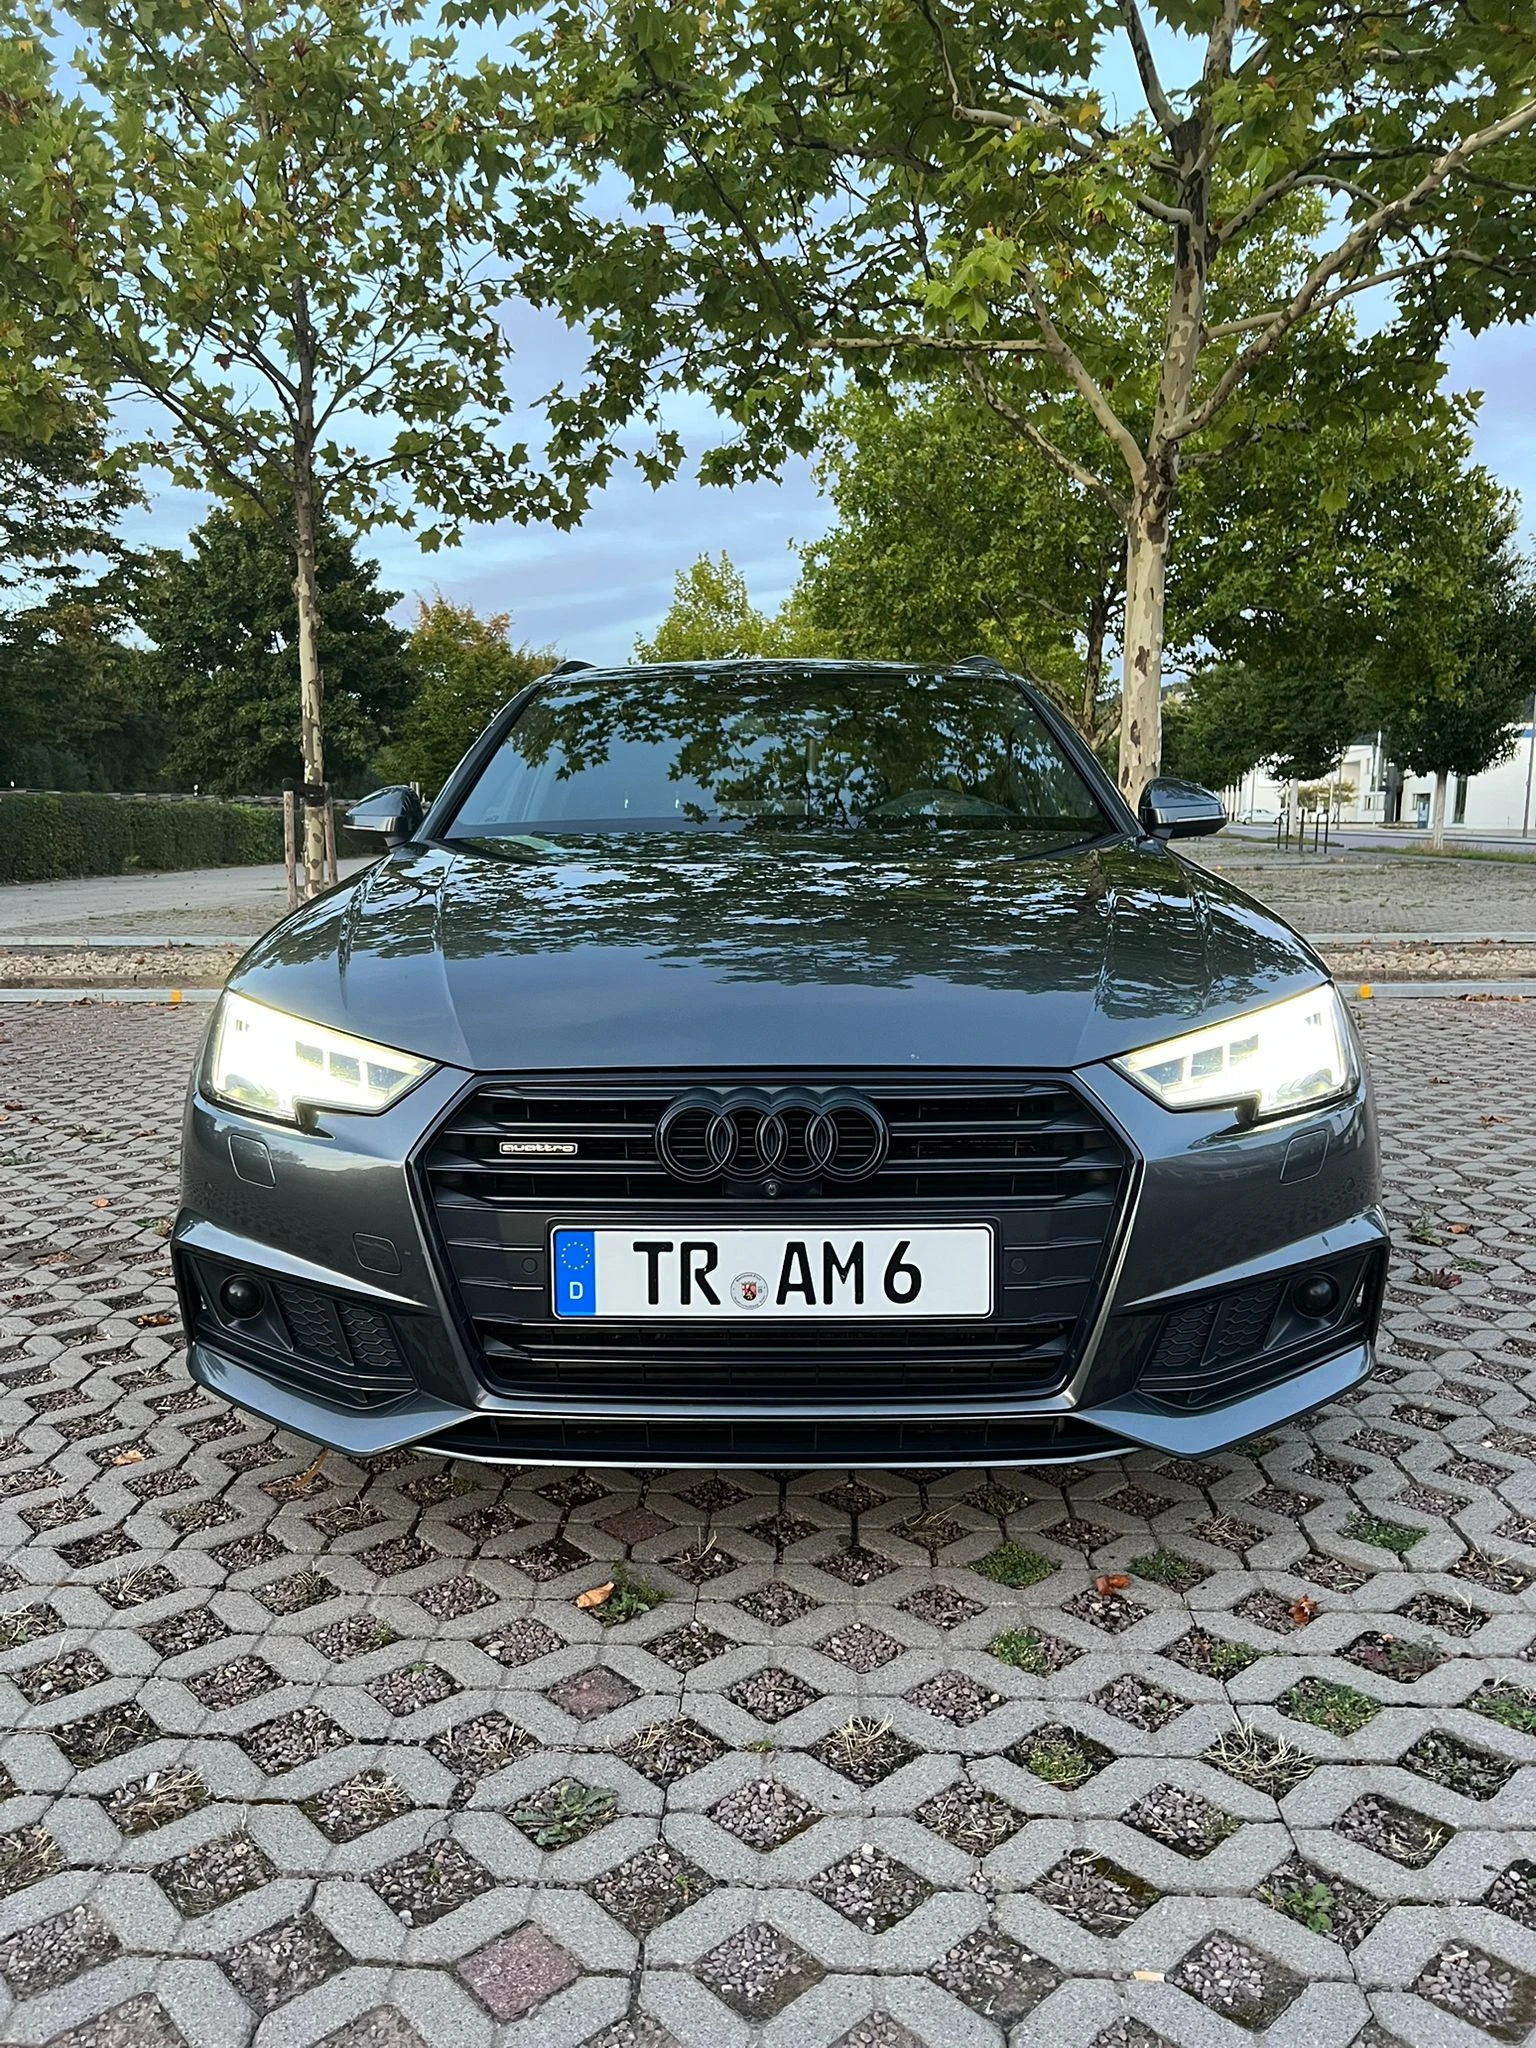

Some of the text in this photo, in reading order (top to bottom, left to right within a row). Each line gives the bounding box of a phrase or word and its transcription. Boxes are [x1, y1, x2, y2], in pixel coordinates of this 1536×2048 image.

[502, 1144, 574, 1152] quattro
[633, 1241, 922, 1305] TR AM 6
[569, 1281, 584, 1300] D
